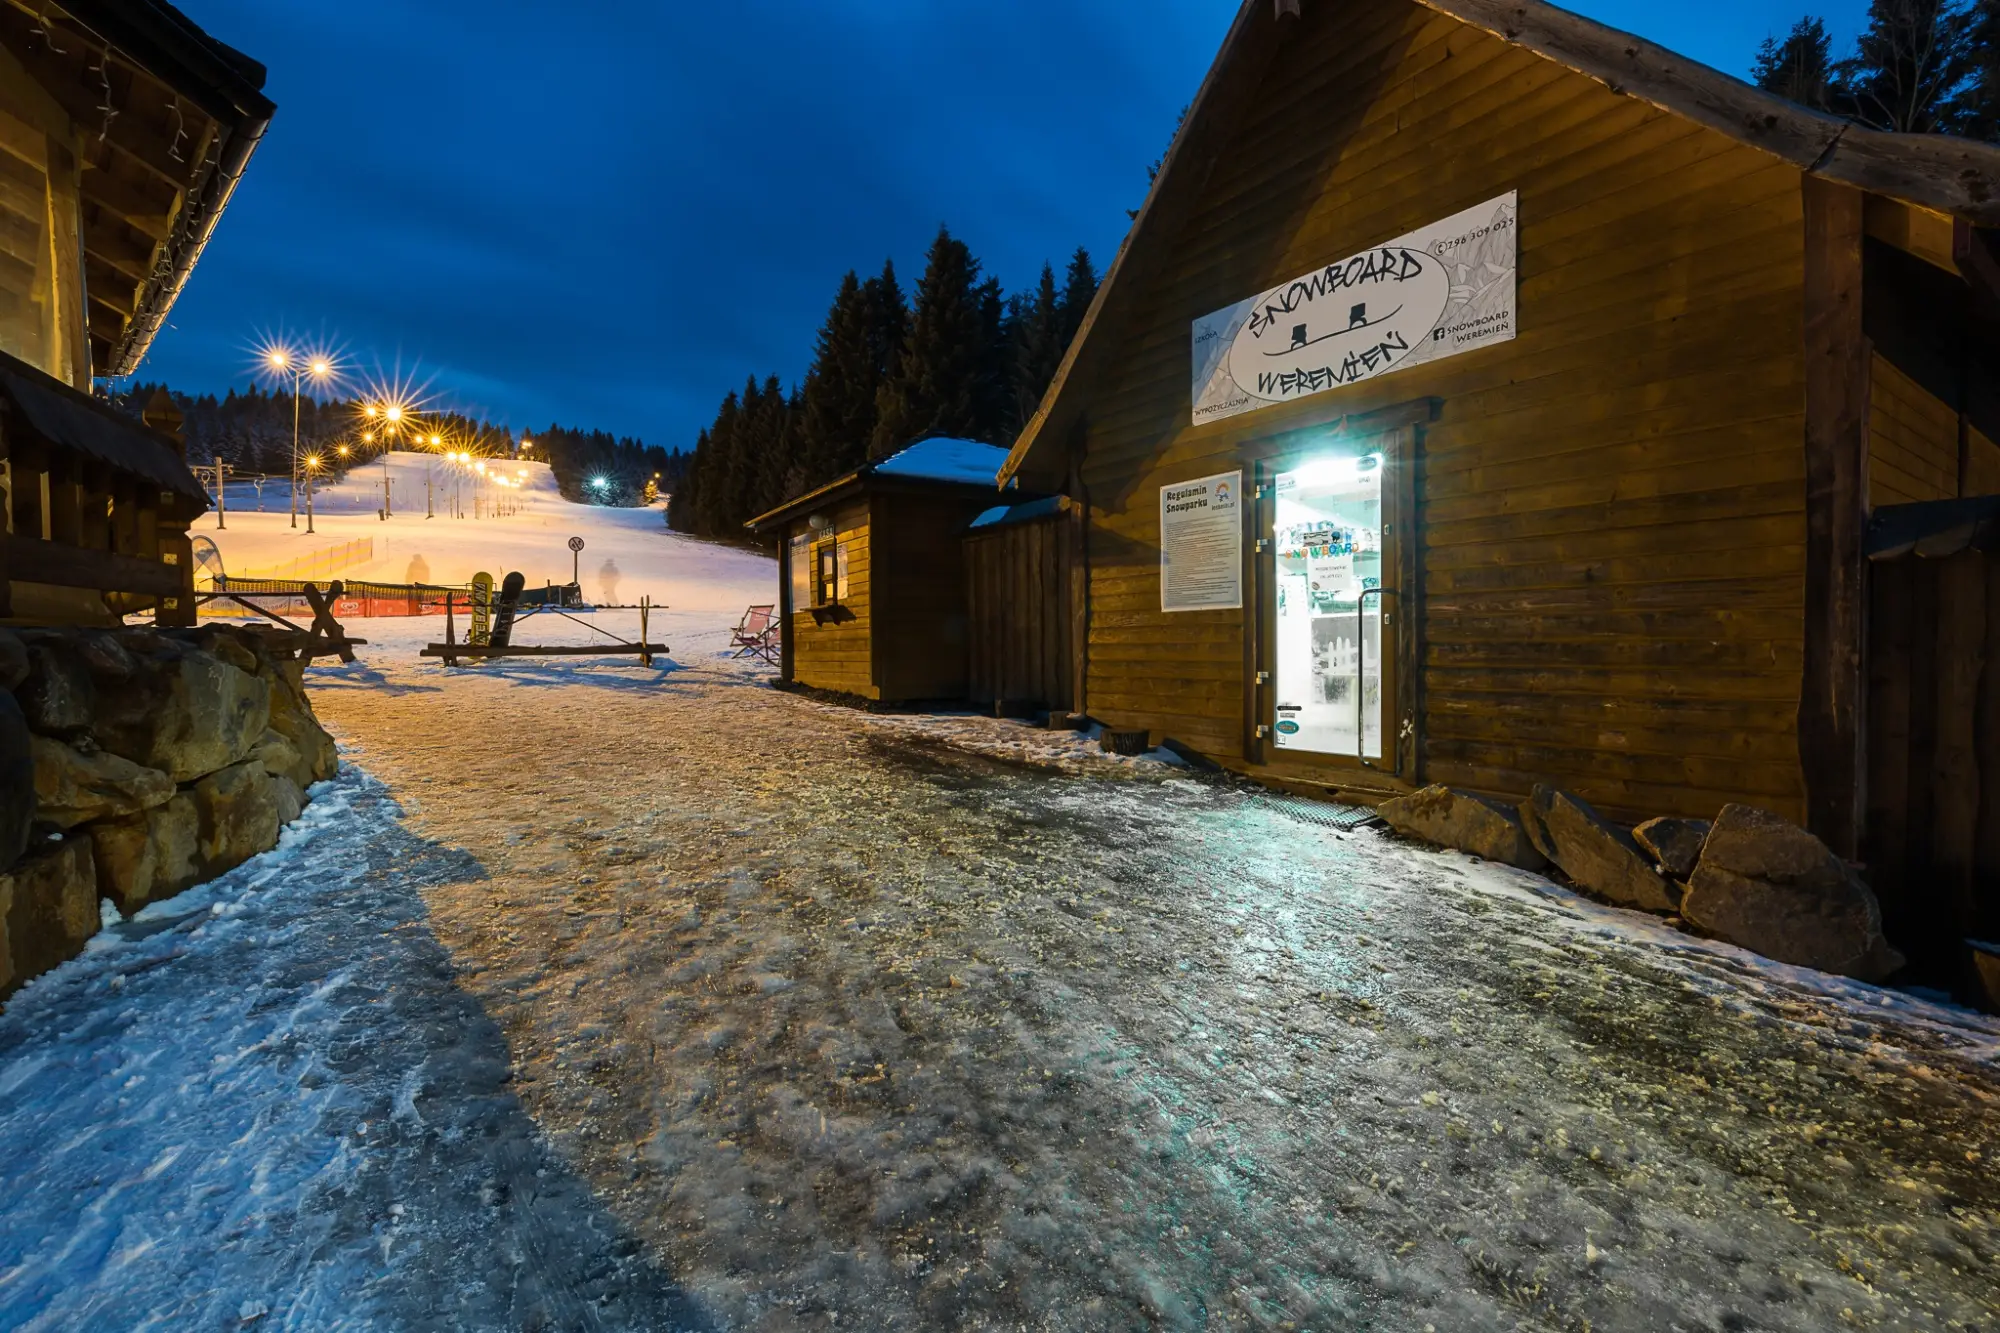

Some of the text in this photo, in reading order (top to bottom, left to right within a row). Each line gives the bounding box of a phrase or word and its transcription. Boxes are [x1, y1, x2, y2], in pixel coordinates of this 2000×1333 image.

[1448, 217, 1515, 250] 796 309 025
[1248, 249, 1423, 338] SNOWBOARD
[1446, 310, 1509, 336] SNOWBOARD
[1166, 485, 1208, 502] Regulamin
[1166, 498, 1208, 513] Snowparku
[1285, 542, 1360, 560] SNOWBOARD
